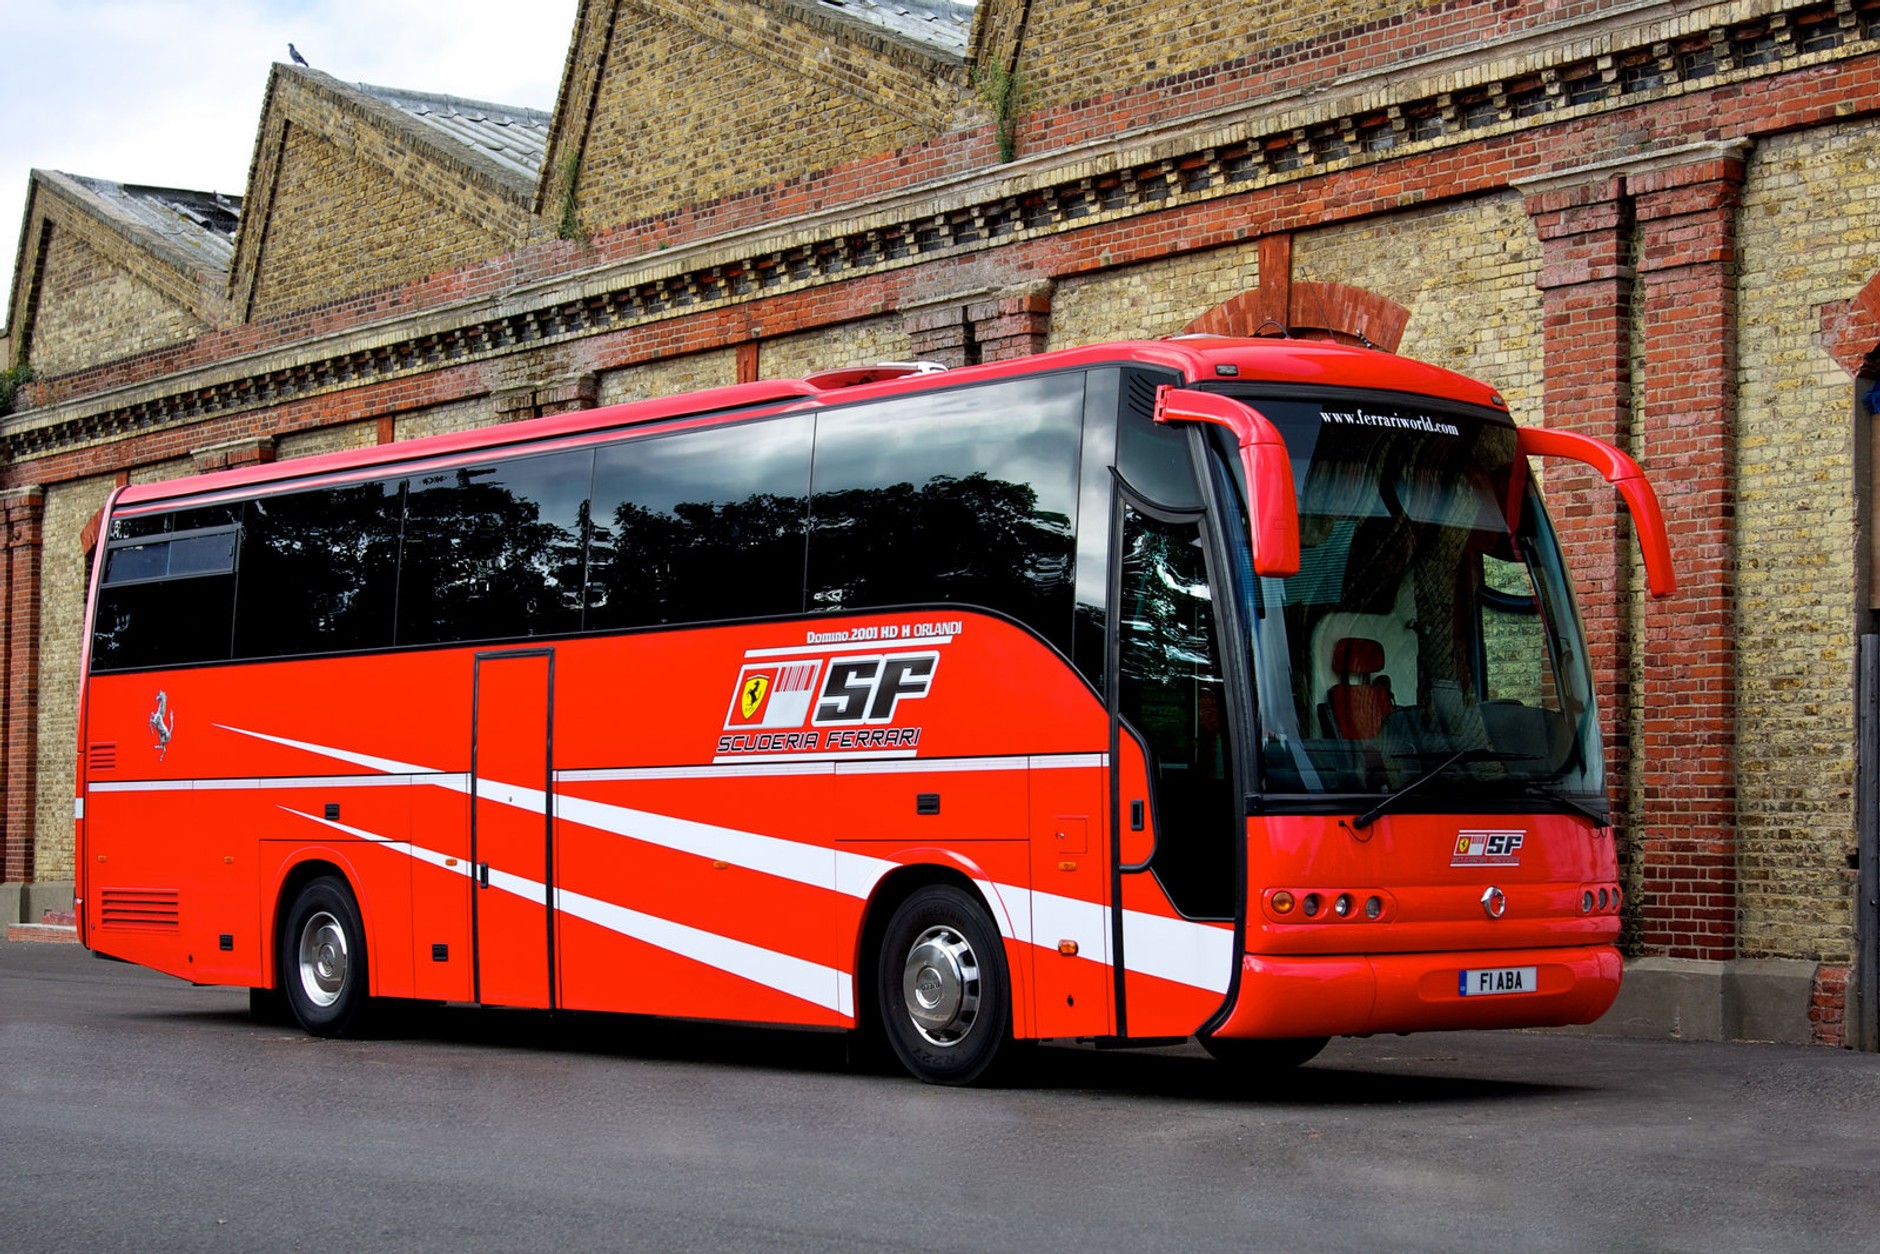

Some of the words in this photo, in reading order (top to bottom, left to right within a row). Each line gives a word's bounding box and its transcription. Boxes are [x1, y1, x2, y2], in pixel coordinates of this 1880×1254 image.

[1320, 408, 1459, 436] www.ferrariworld.com
[914, 621, 962, 636] ORLANDI
[813, 652, 939, 725] SF
[717, 731, 819, 752] SCUDERIA
[826, 727, 921, 749] FERRARI
[1485, 834, 1523, 856] SF
[1497, 970, 1522, 990] ABA
